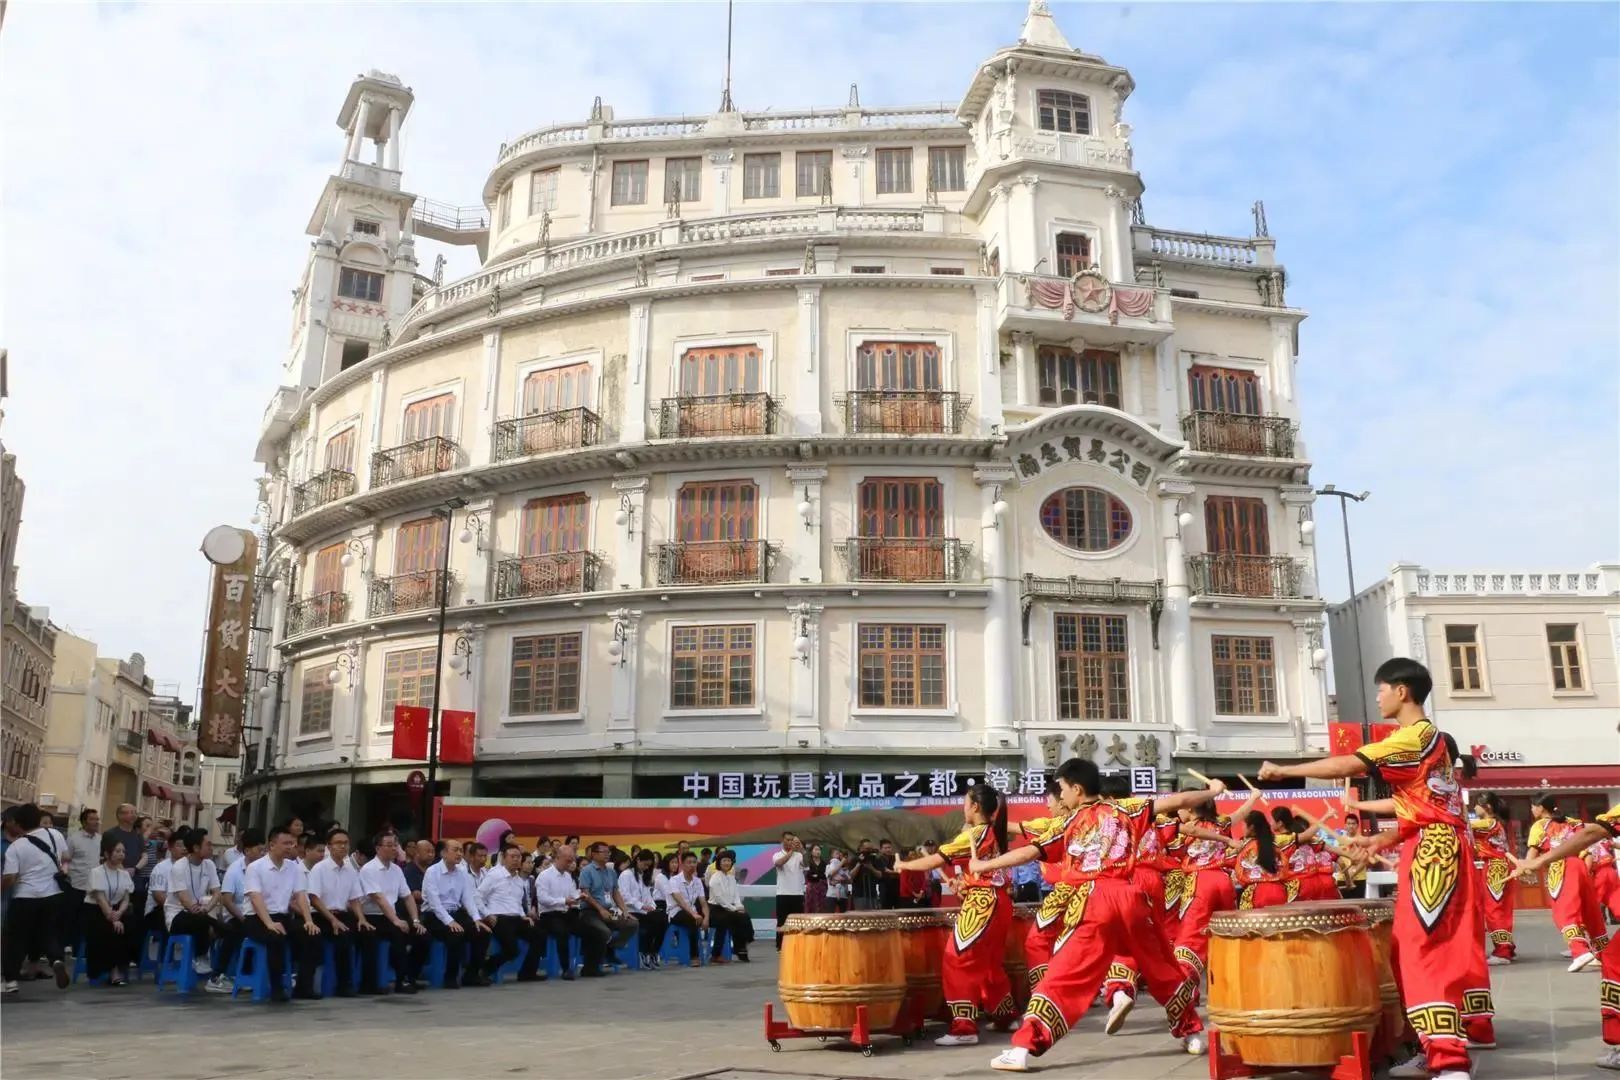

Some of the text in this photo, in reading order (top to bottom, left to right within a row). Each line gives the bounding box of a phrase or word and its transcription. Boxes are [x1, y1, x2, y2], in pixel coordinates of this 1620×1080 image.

[1481, 752, 1521, 760] COFFEE
[1272, 791, 1288, 799] TOY
[1291, 789, 1345, 799] ASSOCIATION
